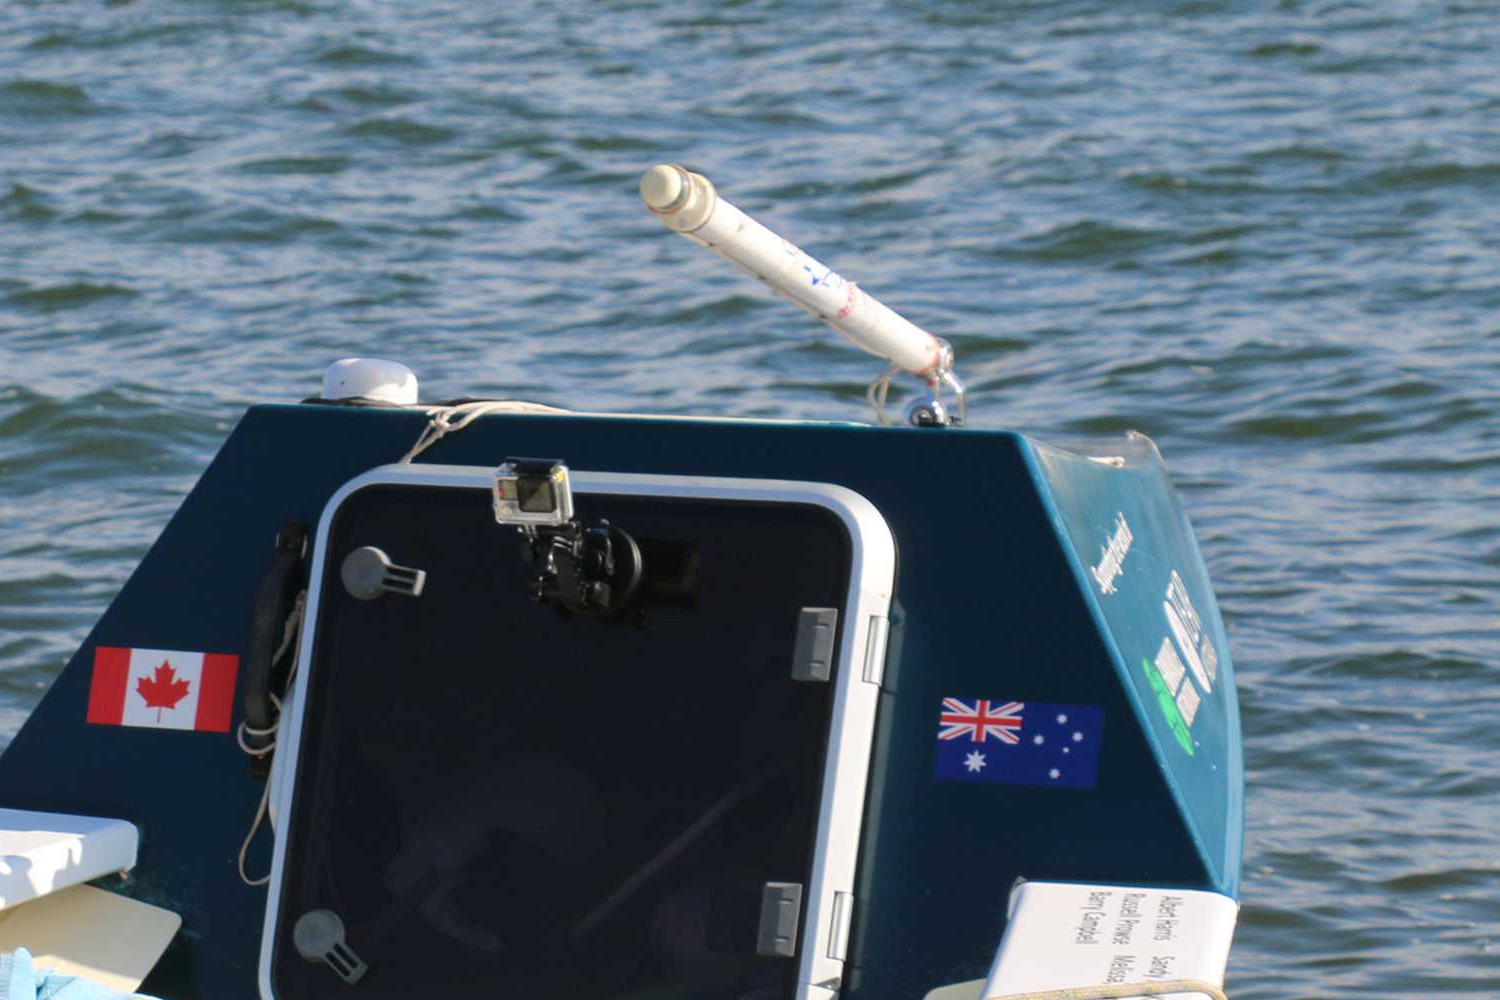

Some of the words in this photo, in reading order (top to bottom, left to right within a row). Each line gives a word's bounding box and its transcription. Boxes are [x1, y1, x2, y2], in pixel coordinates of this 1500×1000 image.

[1080, 892, 1112, 909] Barry
[1119, 893, 1147, 917] Russell
[1156, 896, 1185, 917] Albert
[1075, 911, 1106, 944] Campbell
[1154, 919, 1180, 941] Harris
